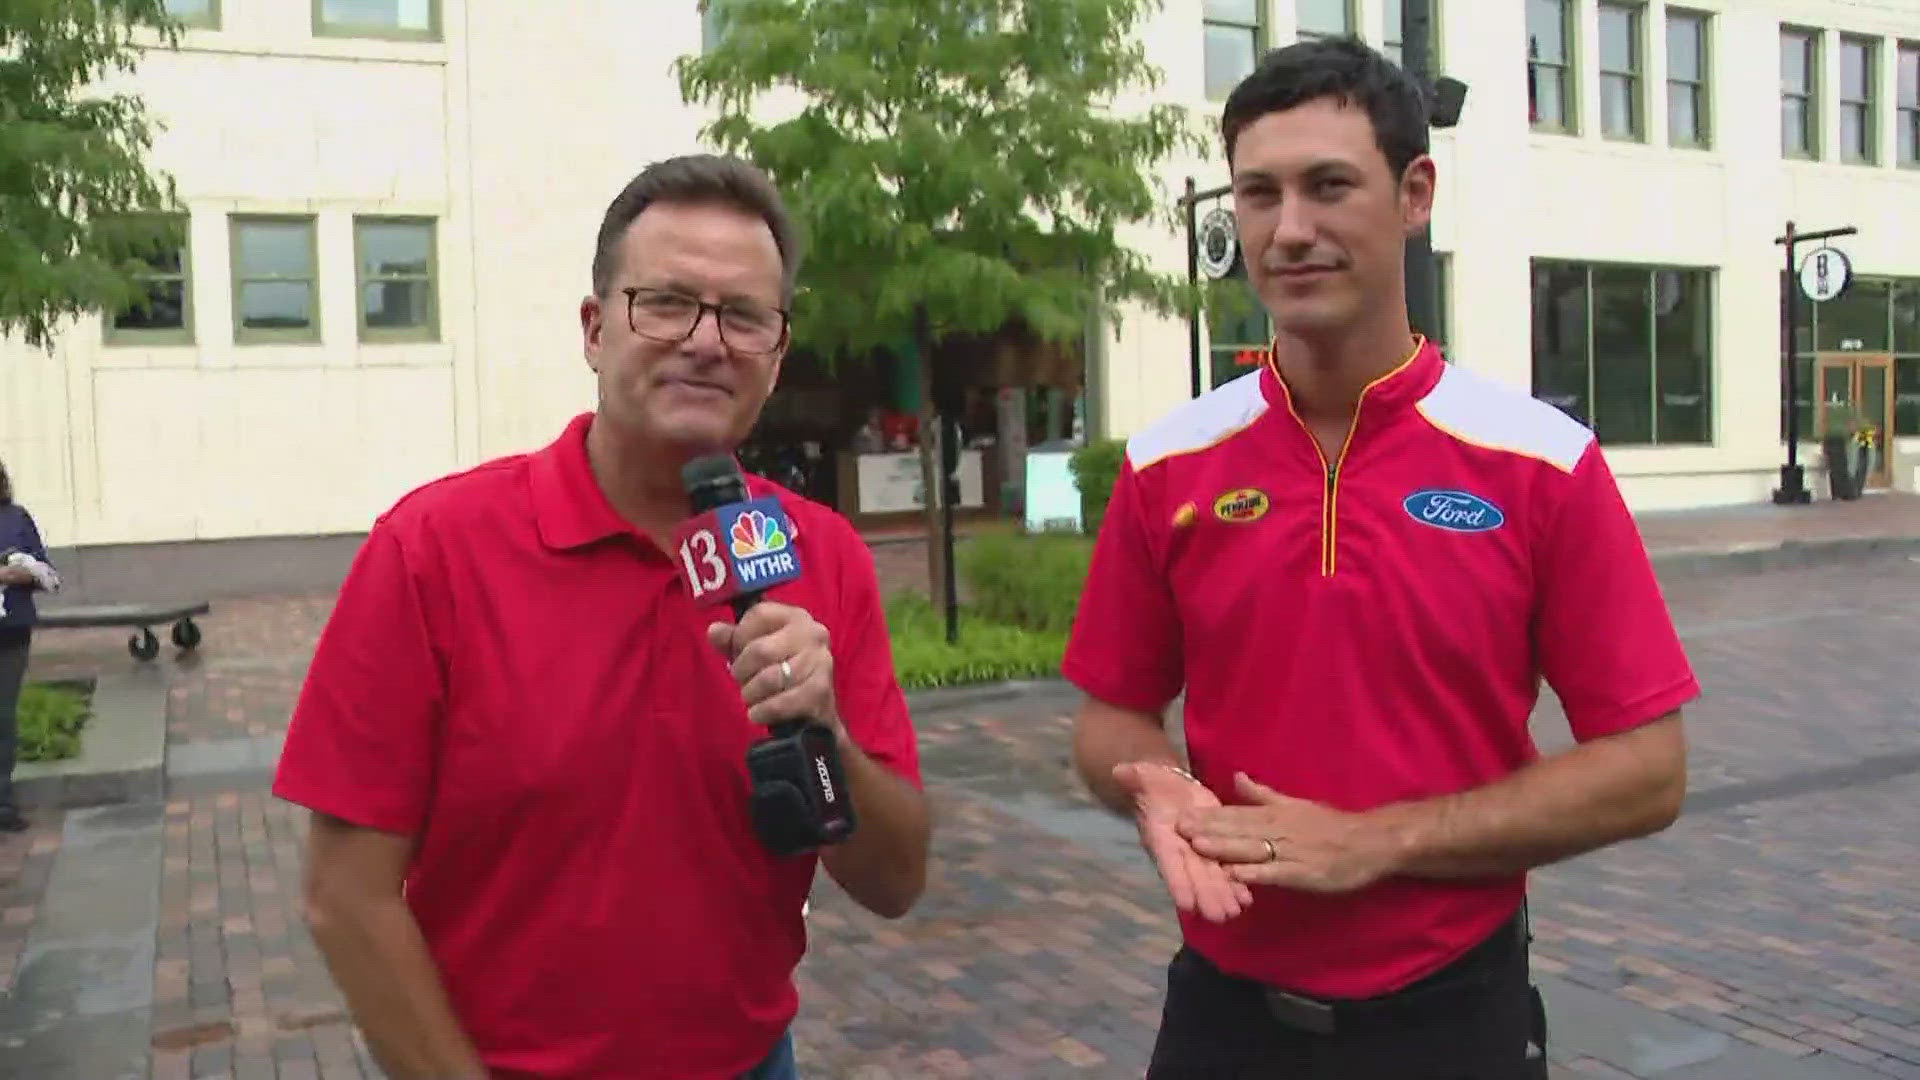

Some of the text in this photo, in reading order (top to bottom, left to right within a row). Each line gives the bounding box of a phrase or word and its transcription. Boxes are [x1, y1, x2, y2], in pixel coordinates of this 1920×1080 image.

[1423, 495, 1485, 526] Ford
[680, 529, 726, 600] 13
[737, 553, 794, 582] WTHR
